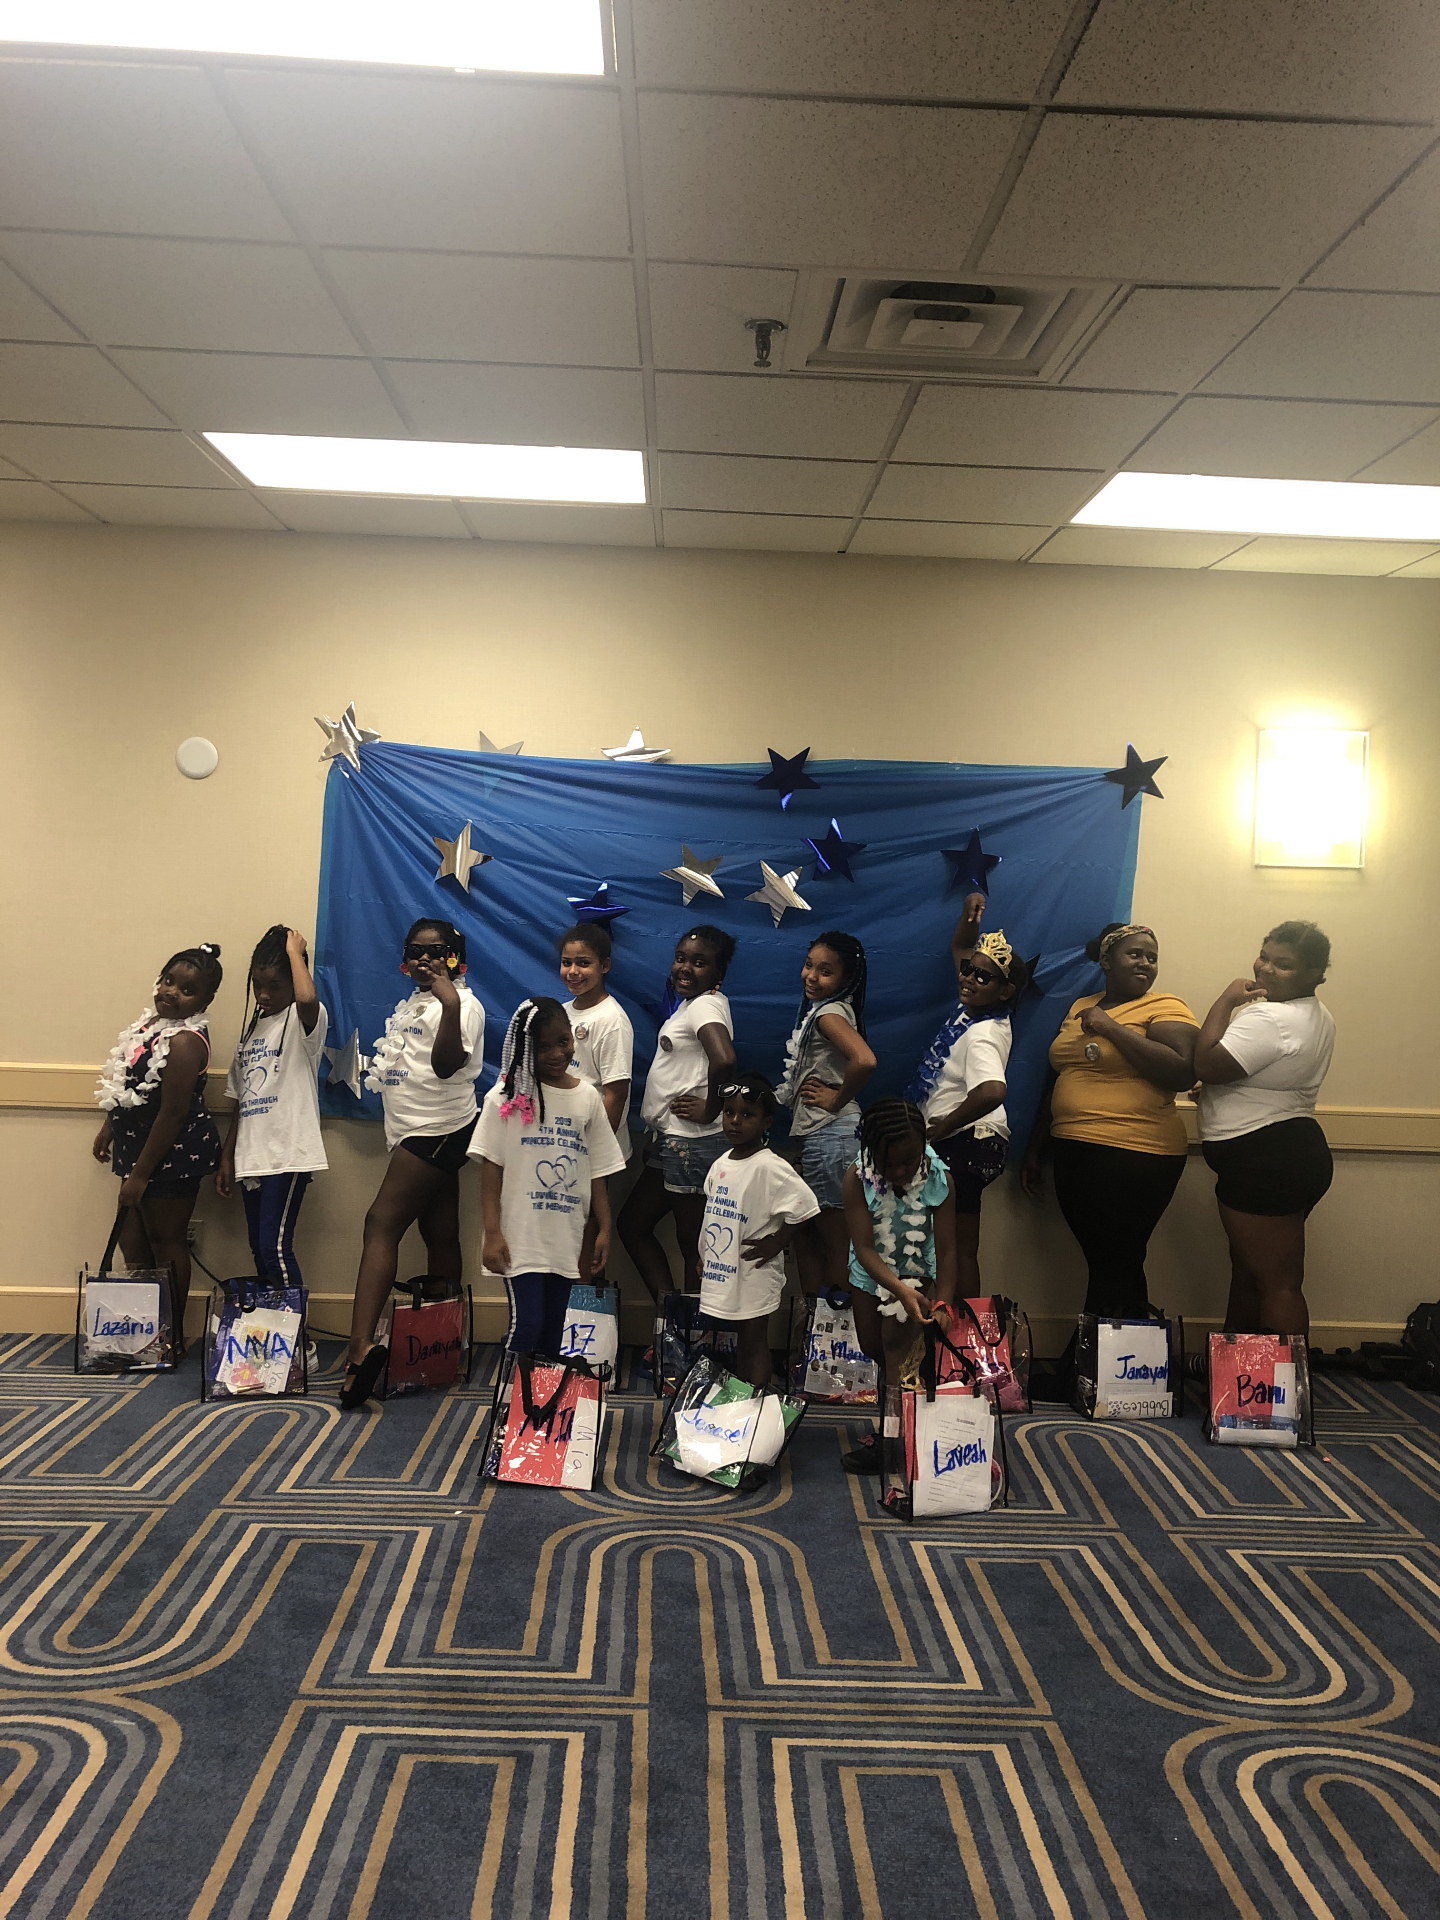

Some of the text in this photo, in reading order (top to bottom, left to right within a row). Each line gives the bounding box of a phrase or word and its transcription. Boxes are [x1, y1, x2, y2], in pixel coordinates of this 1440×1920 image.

[252, 1038, 265, 1047] 2019
[248, 1095, 279, 1107] THROUGH
[716, 1185, 729, 1196] 2019
[714, 1195, 738, 1210] ANNUAL
[706, 1259, 738, 1275] THROUGH
[1122, 1399, 1169, 1417] Bubbles
[572, 1424, 598, 1470] Mia
